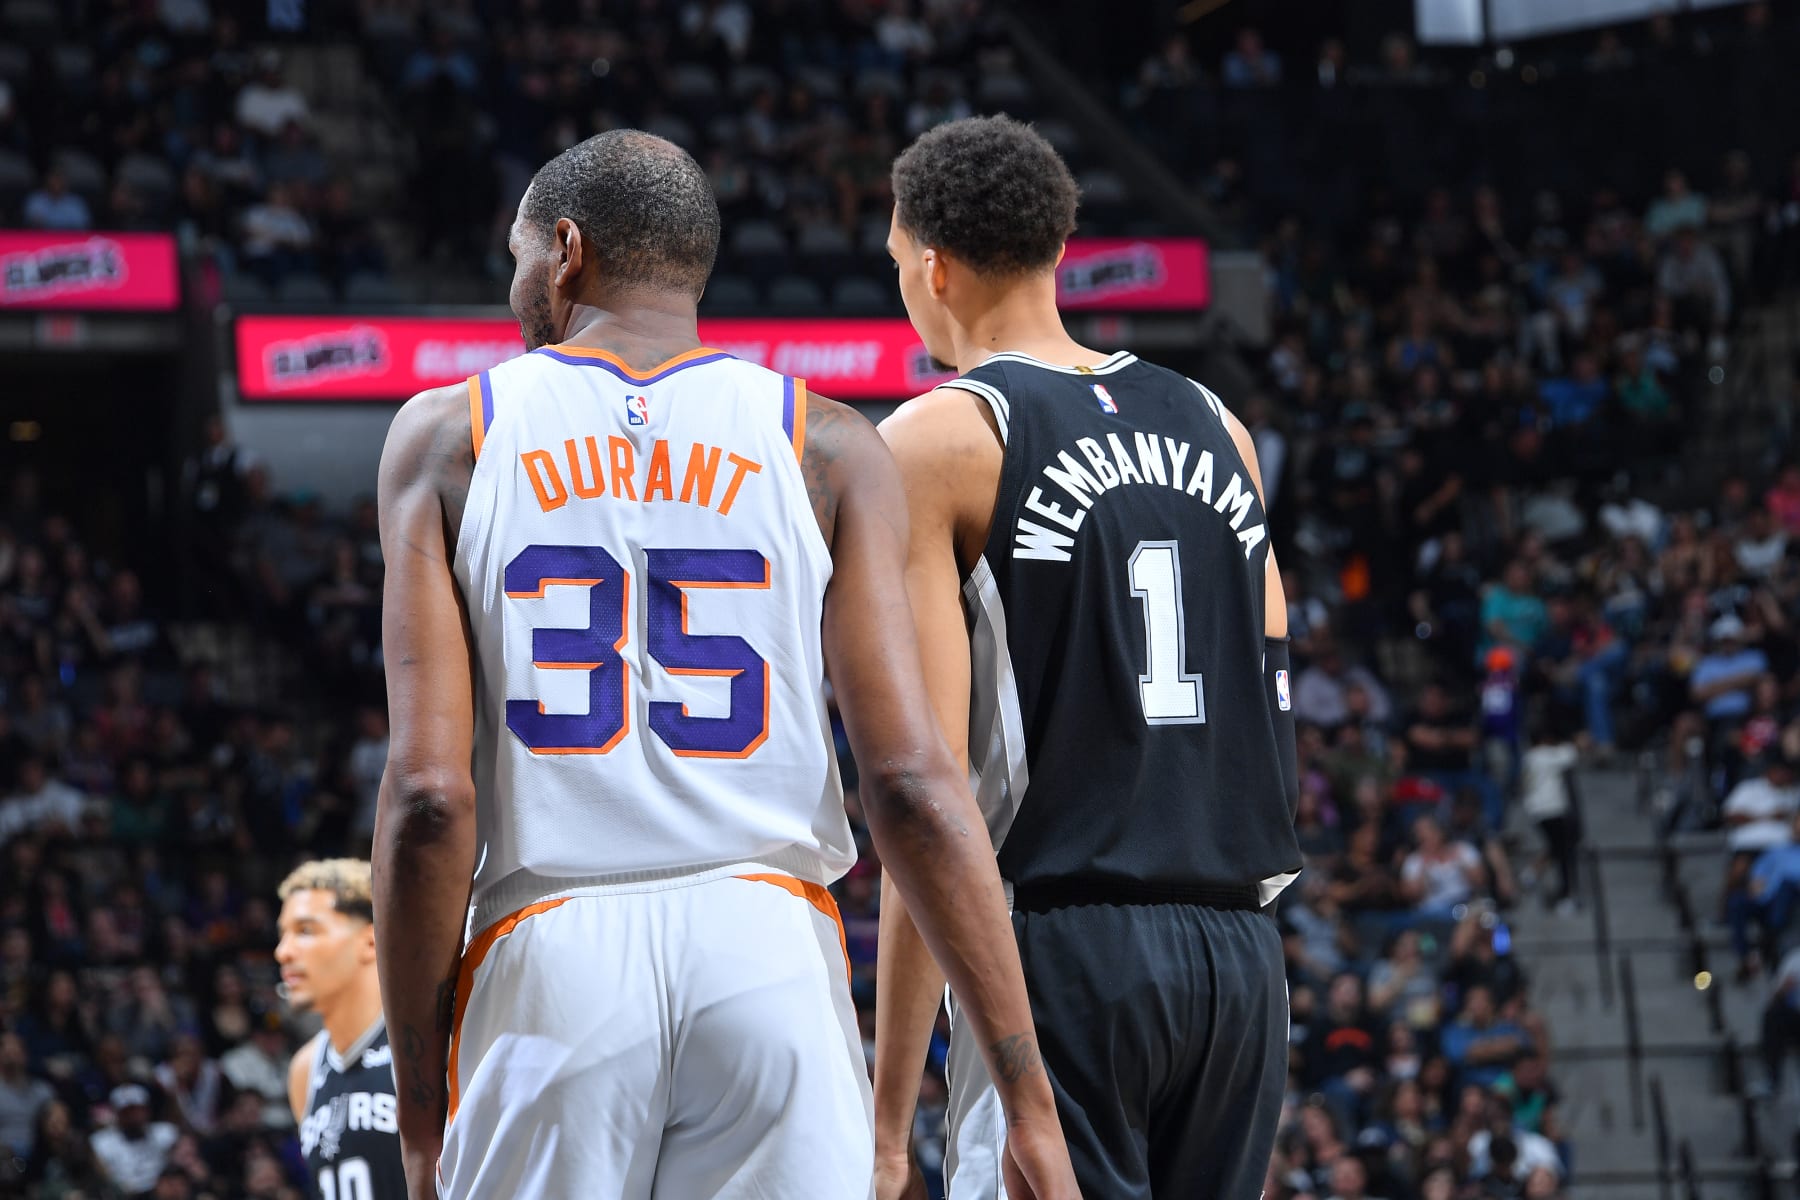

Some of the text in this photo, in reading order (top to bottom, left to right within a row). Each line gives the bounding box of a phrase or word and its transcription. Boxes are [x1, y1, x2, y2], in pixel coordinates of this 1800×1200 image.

[520, 435, 763, 517] DURANT
[1012, 431, 1266, 562] WEMBANYAMA
[504, 544, 771, 759] 35
[1127, 539, 1206, 726] 1
